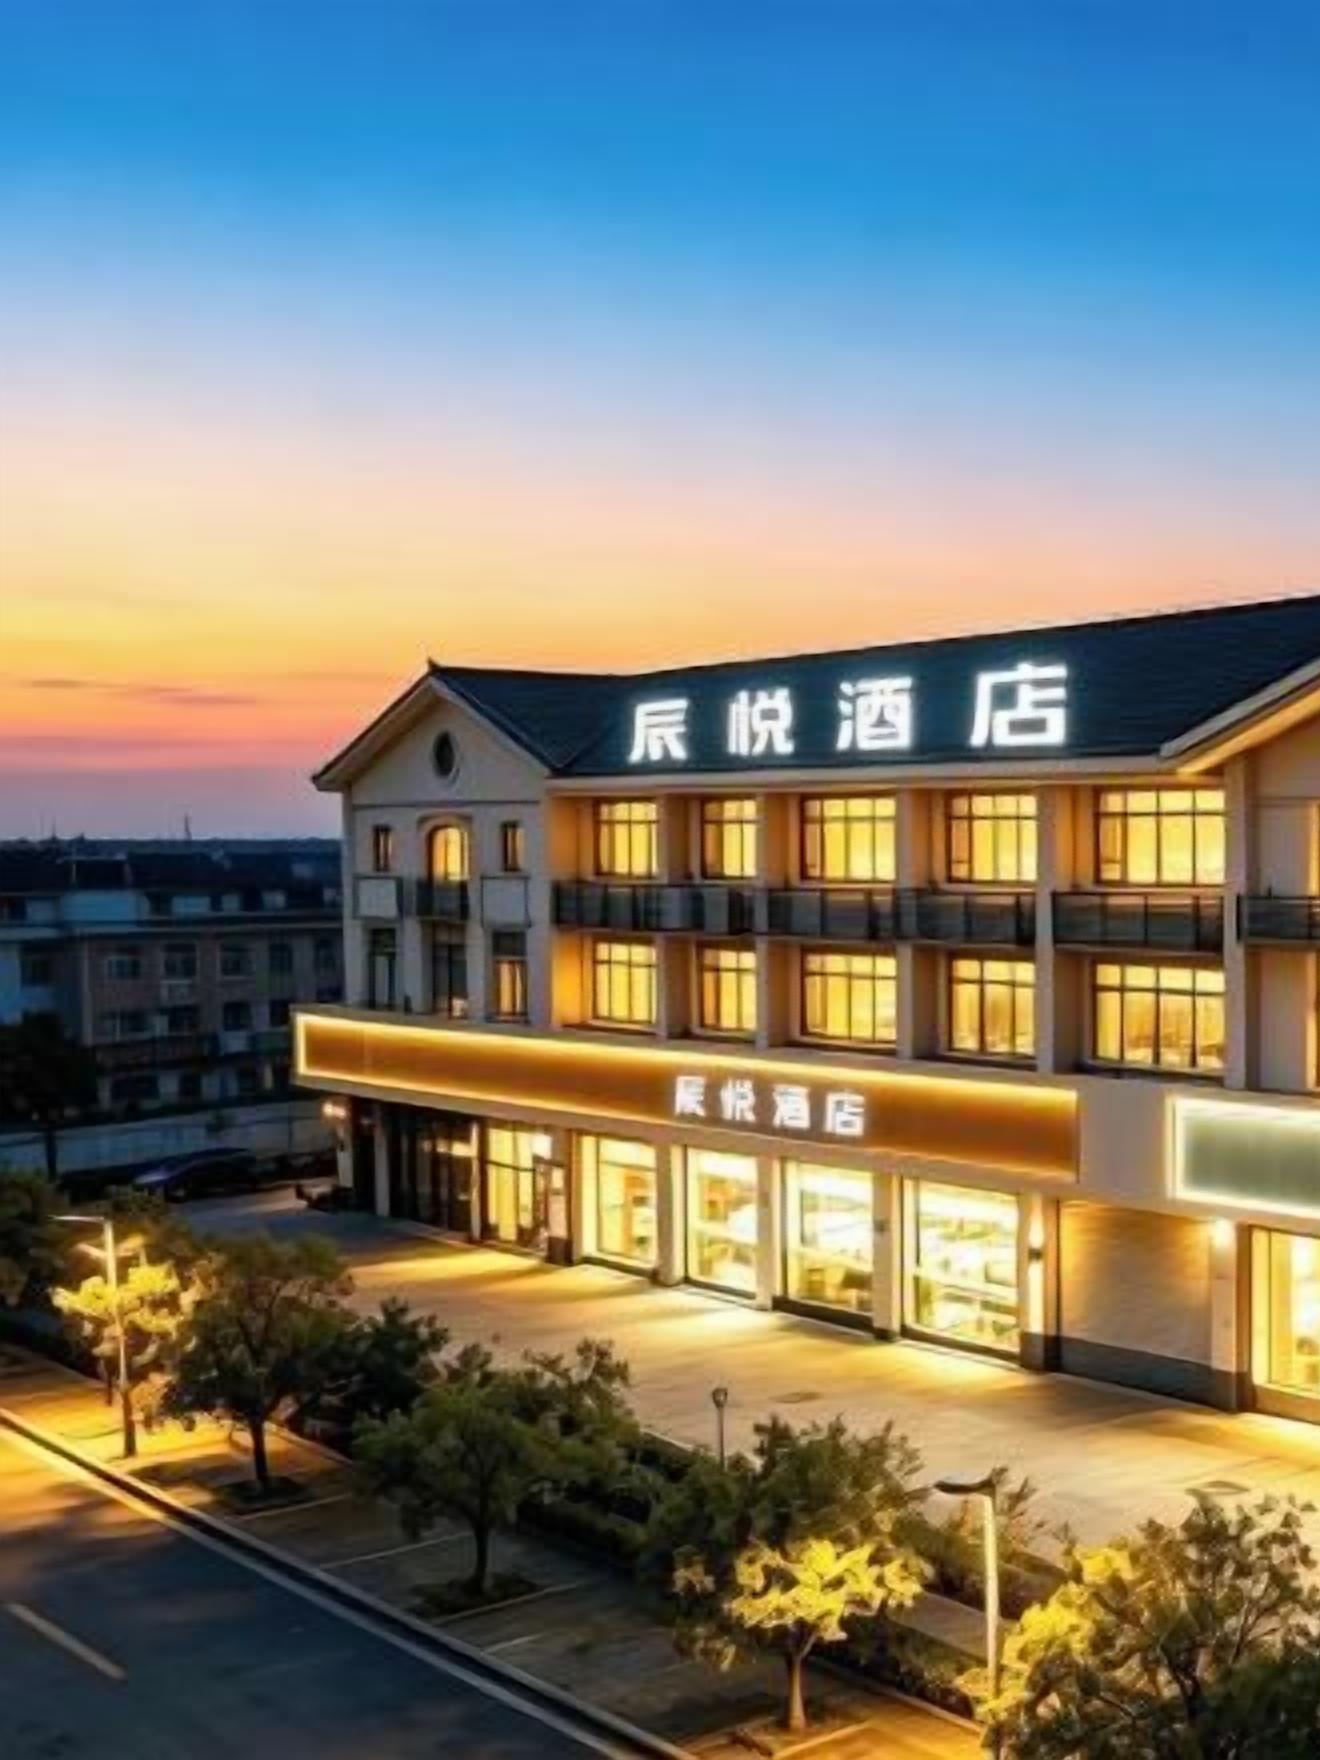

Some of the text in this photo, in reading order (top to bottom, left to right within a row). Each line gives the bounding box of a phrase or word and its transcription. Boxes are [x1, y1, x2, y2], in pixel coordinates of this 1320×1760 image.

[628, 662, 1068, 763] 辰悦酒店
[674, 1075, 865, 1136] 辰悦酒店
